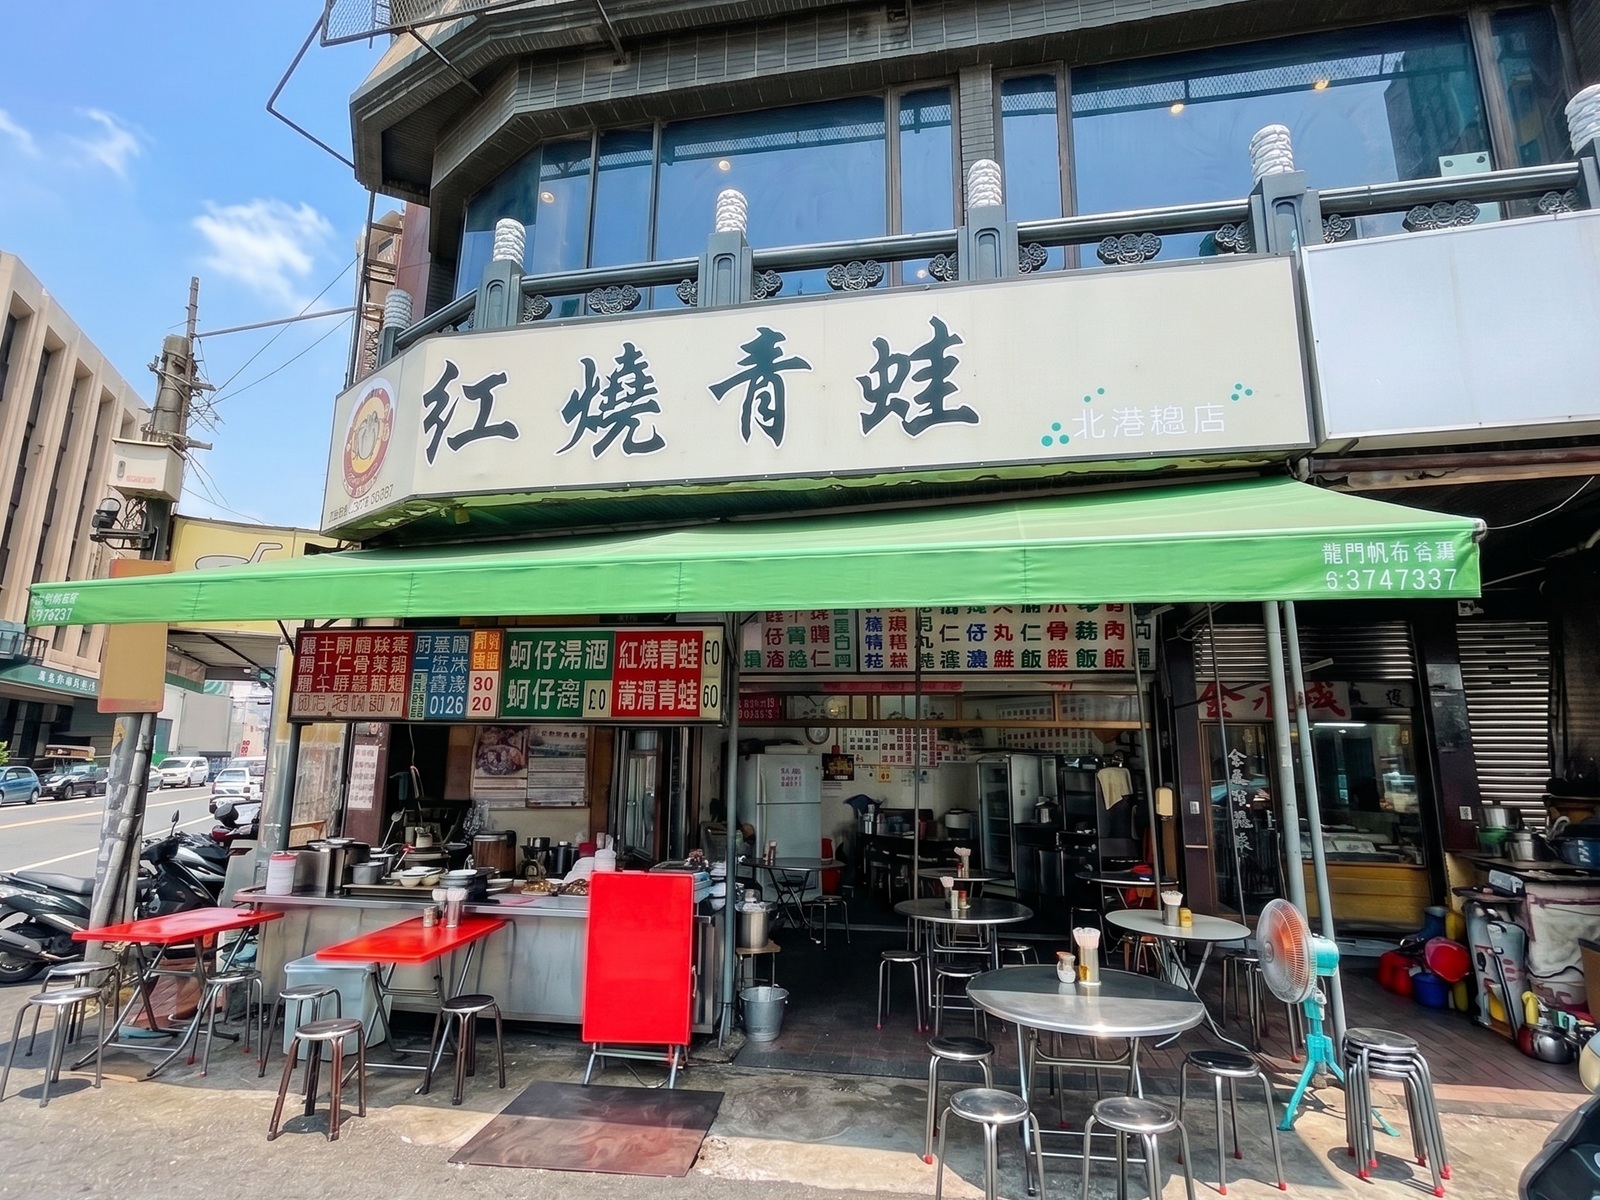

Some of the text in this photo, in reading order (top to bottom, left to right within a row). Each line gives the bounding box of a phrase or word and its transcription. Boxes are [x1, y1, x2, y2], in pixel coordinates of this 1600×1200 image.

[618, 638, 699, 670] 紅燒青蛙
[473, 677, 493, 691] 30
[472, 697, 492, 711] 20
[703, 684, 718, 709] 60
